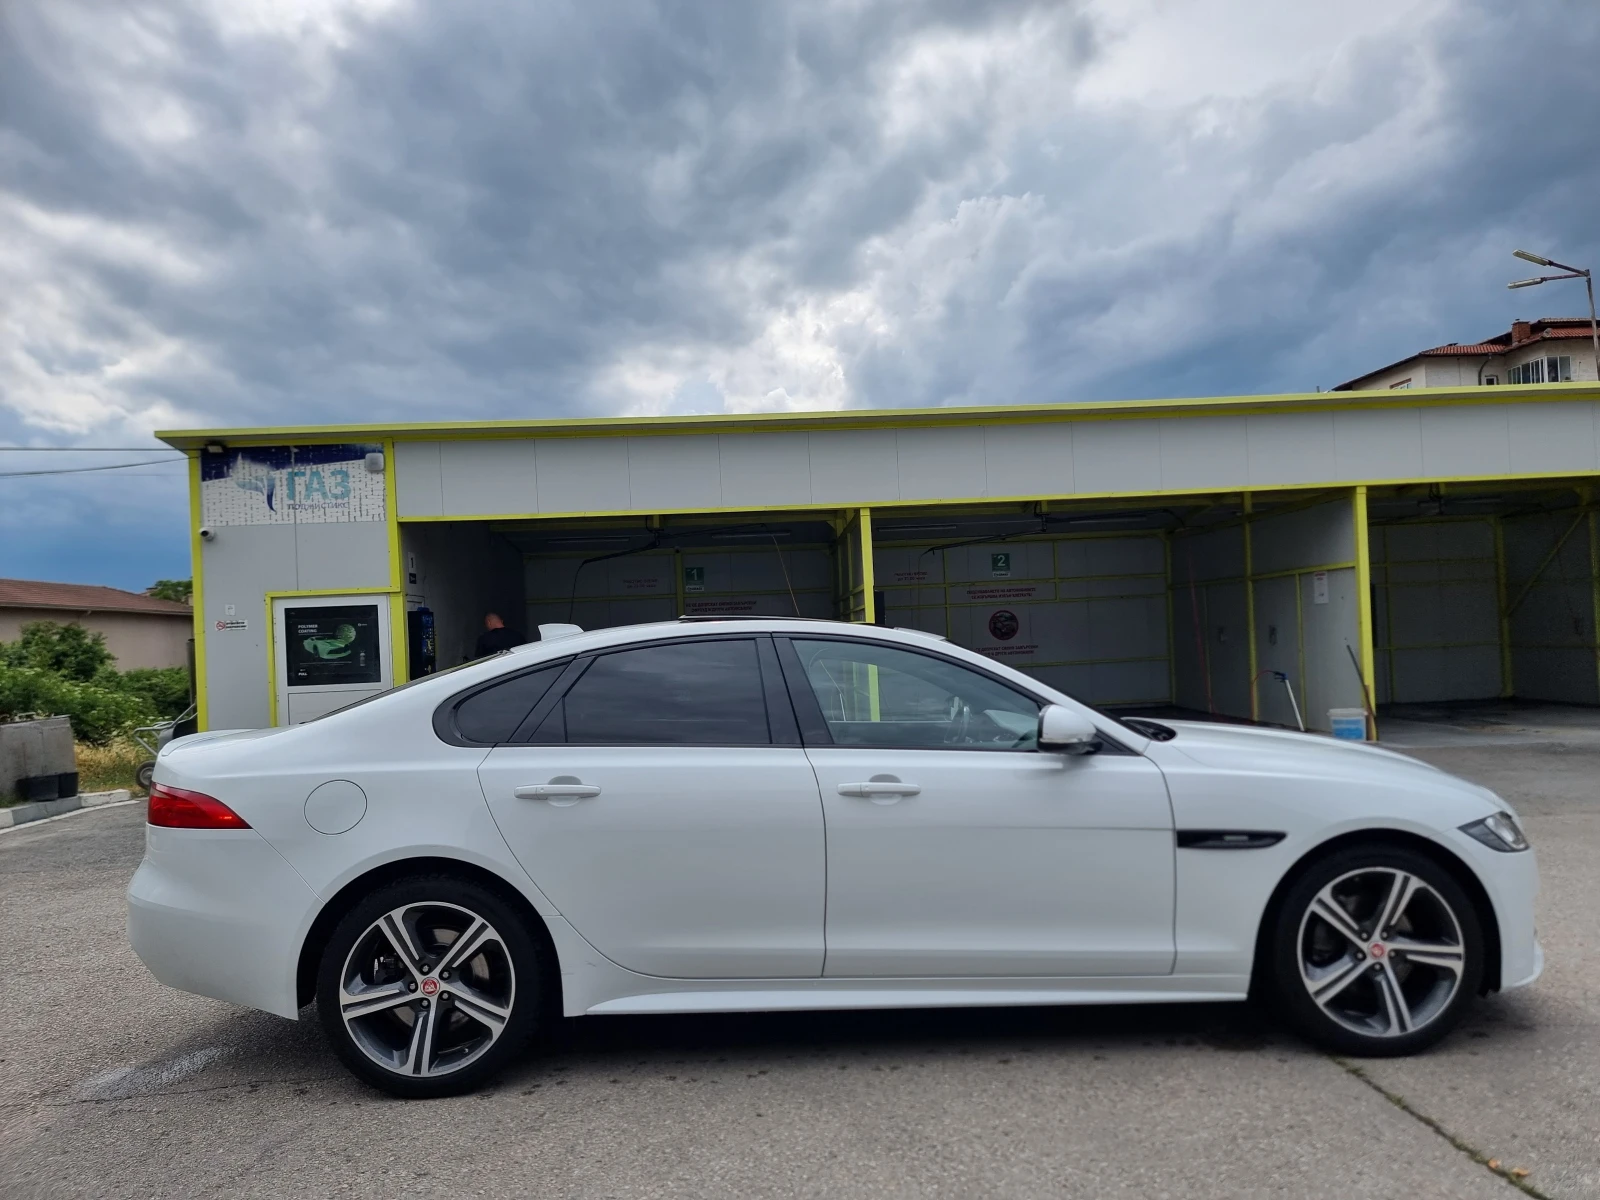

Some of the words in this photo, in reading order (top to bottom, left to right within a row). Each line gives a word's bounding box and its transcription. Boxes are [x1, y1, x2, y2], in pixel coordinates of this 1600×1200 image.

[286, 469, 351, 501] ГАЗ
[997, 554, 1006, 567] 2
[691, 568, 698, 581] 1
